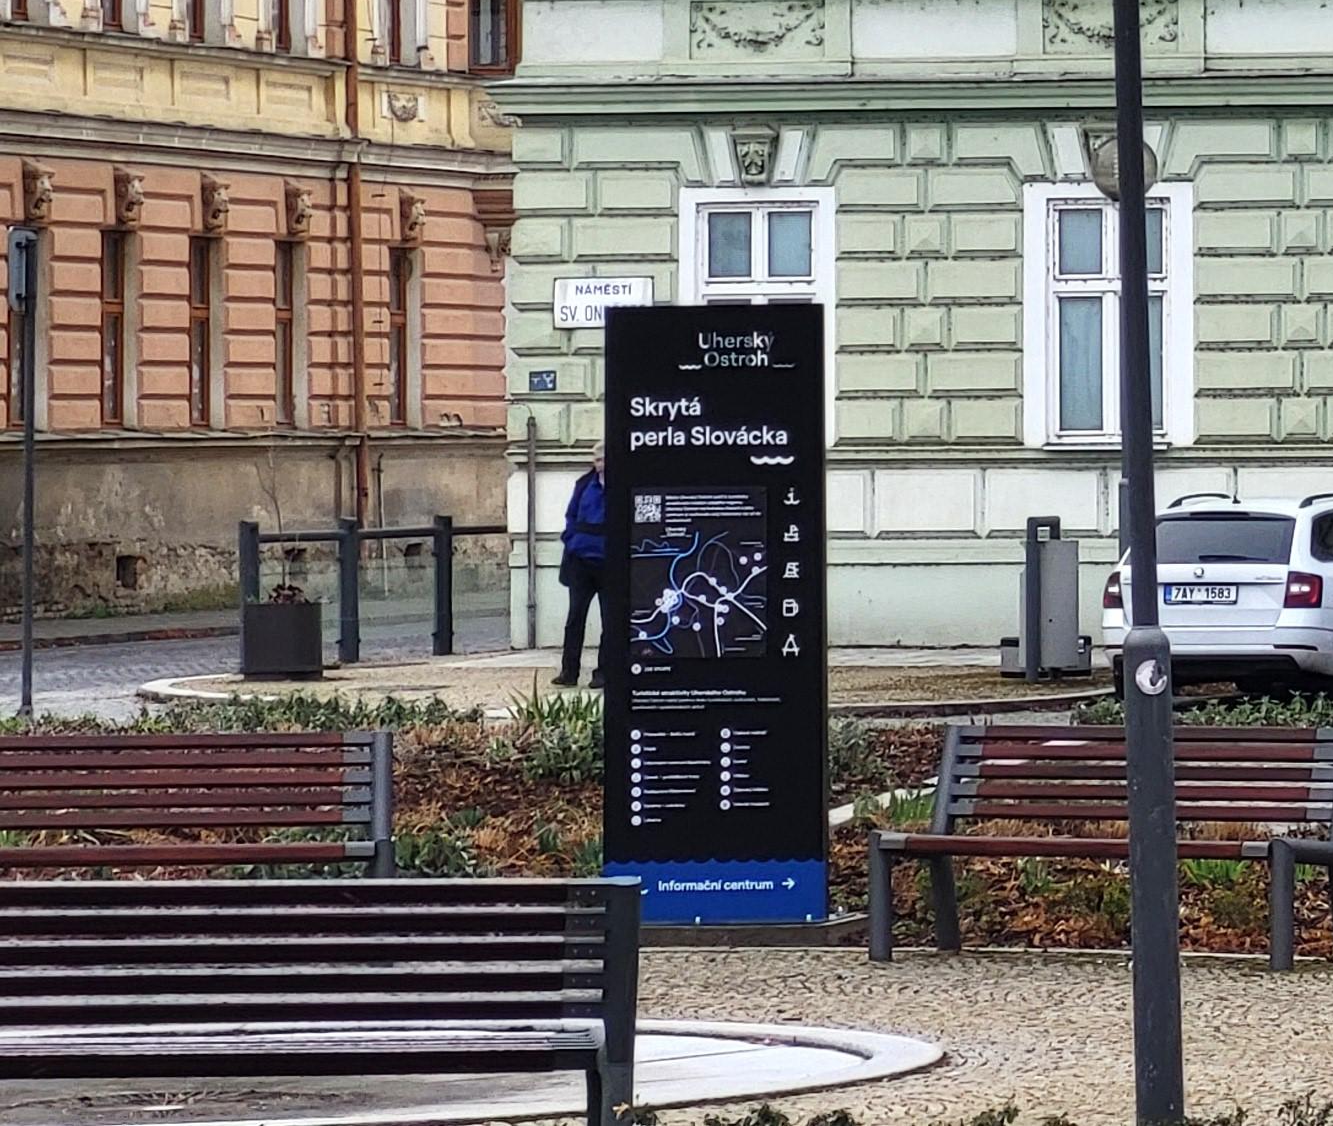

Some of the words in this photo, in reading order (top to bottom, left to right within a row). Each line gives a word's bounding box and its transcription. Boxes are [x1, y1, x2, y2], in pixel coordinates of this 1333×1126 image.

[575, 284, 632, 296] NÁMĚSTÍ
[560, 305, 580, 323] SV.
[698, 331, 775, 352] Uherský
[703, 350, 769, 367] Ostroh
[629, 397, 702, 421] Skrytá
[630, 427, 686, 452] perla
[690, 426, 789, 446] Slovácka
[1174, 587, 1196, 599] 7AY
[658, 879, 723, 892] Informační
[723, 879, 774, 891] centrum
